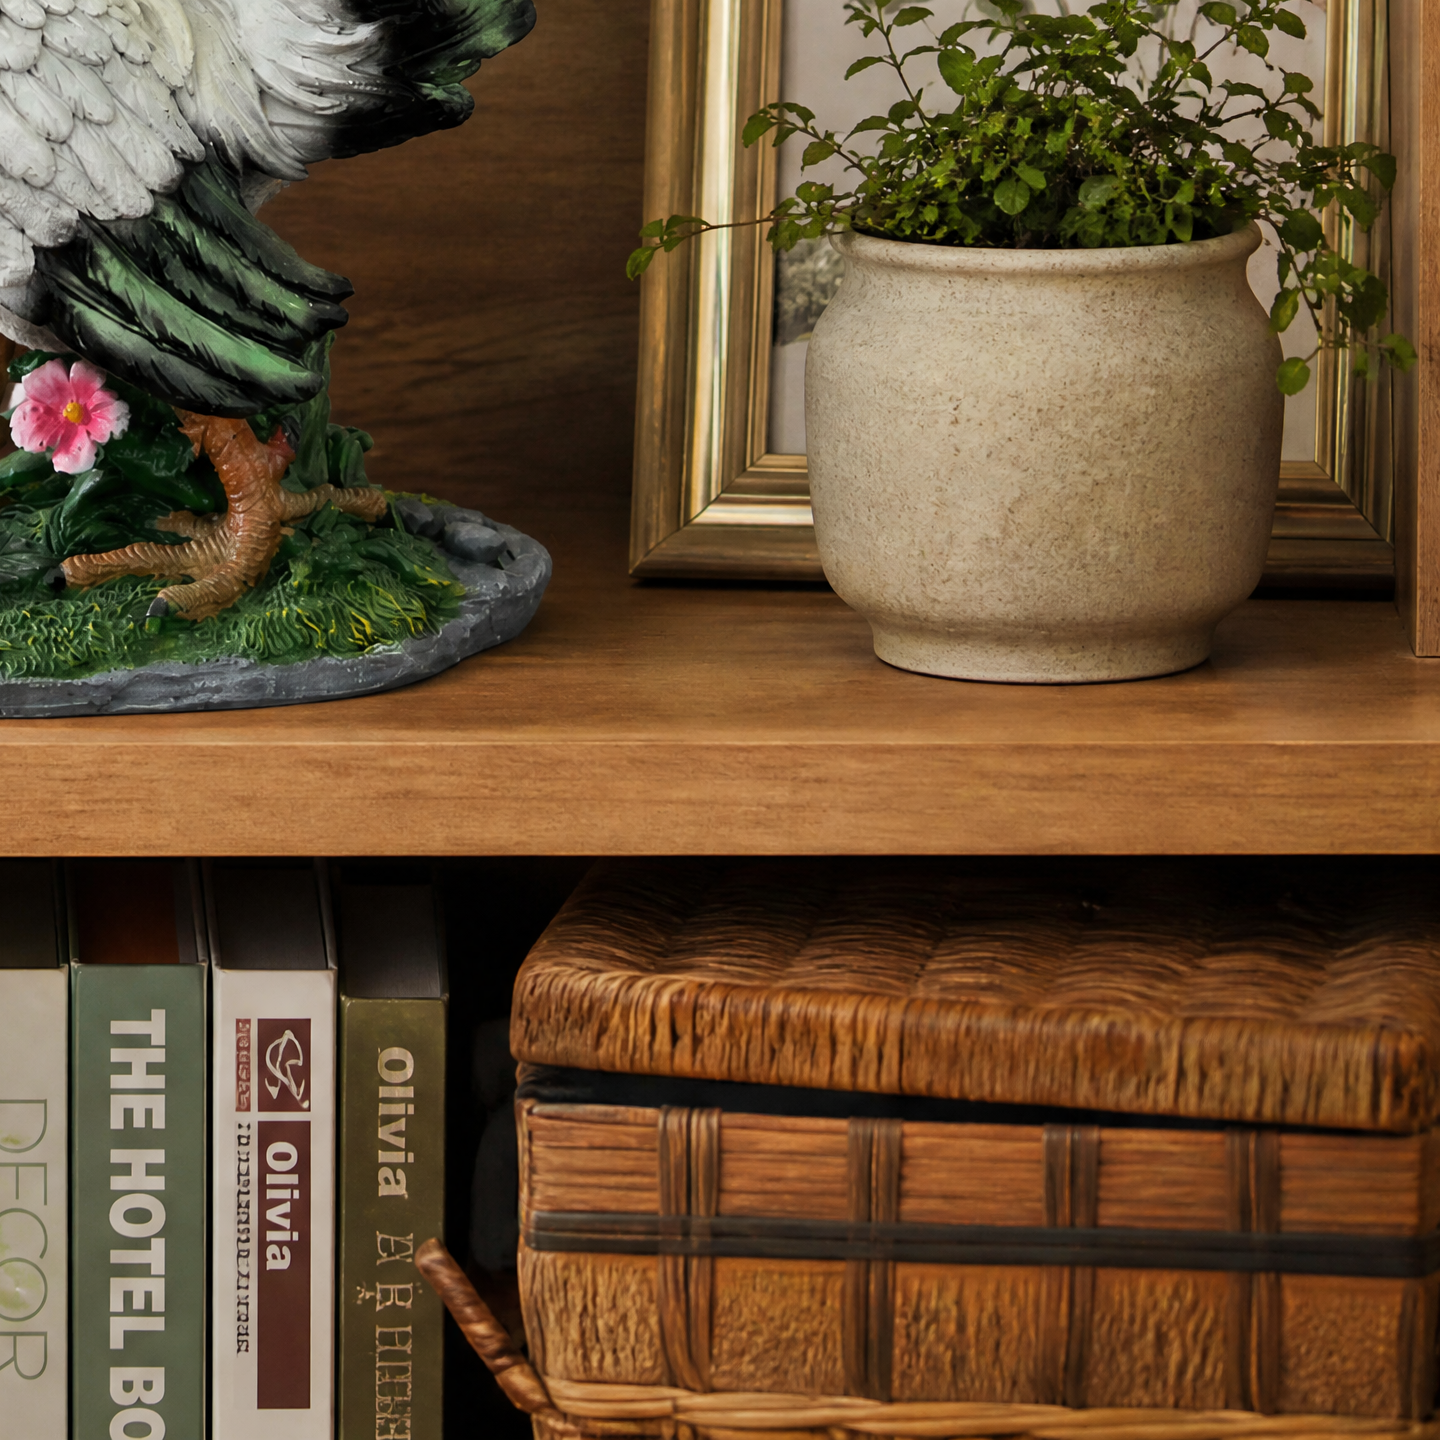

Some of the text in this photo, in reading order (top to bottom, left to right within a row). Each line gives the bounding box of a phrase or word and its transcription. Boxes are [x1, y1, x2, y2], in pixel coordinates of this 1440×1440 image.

[110, 1009, 165, 1129] THE
[378, 1047, 414, 1199] Olivia
[109, 1149, 165, 1349] HOTEL
[266, 1142, 299, 1270] Olivia
